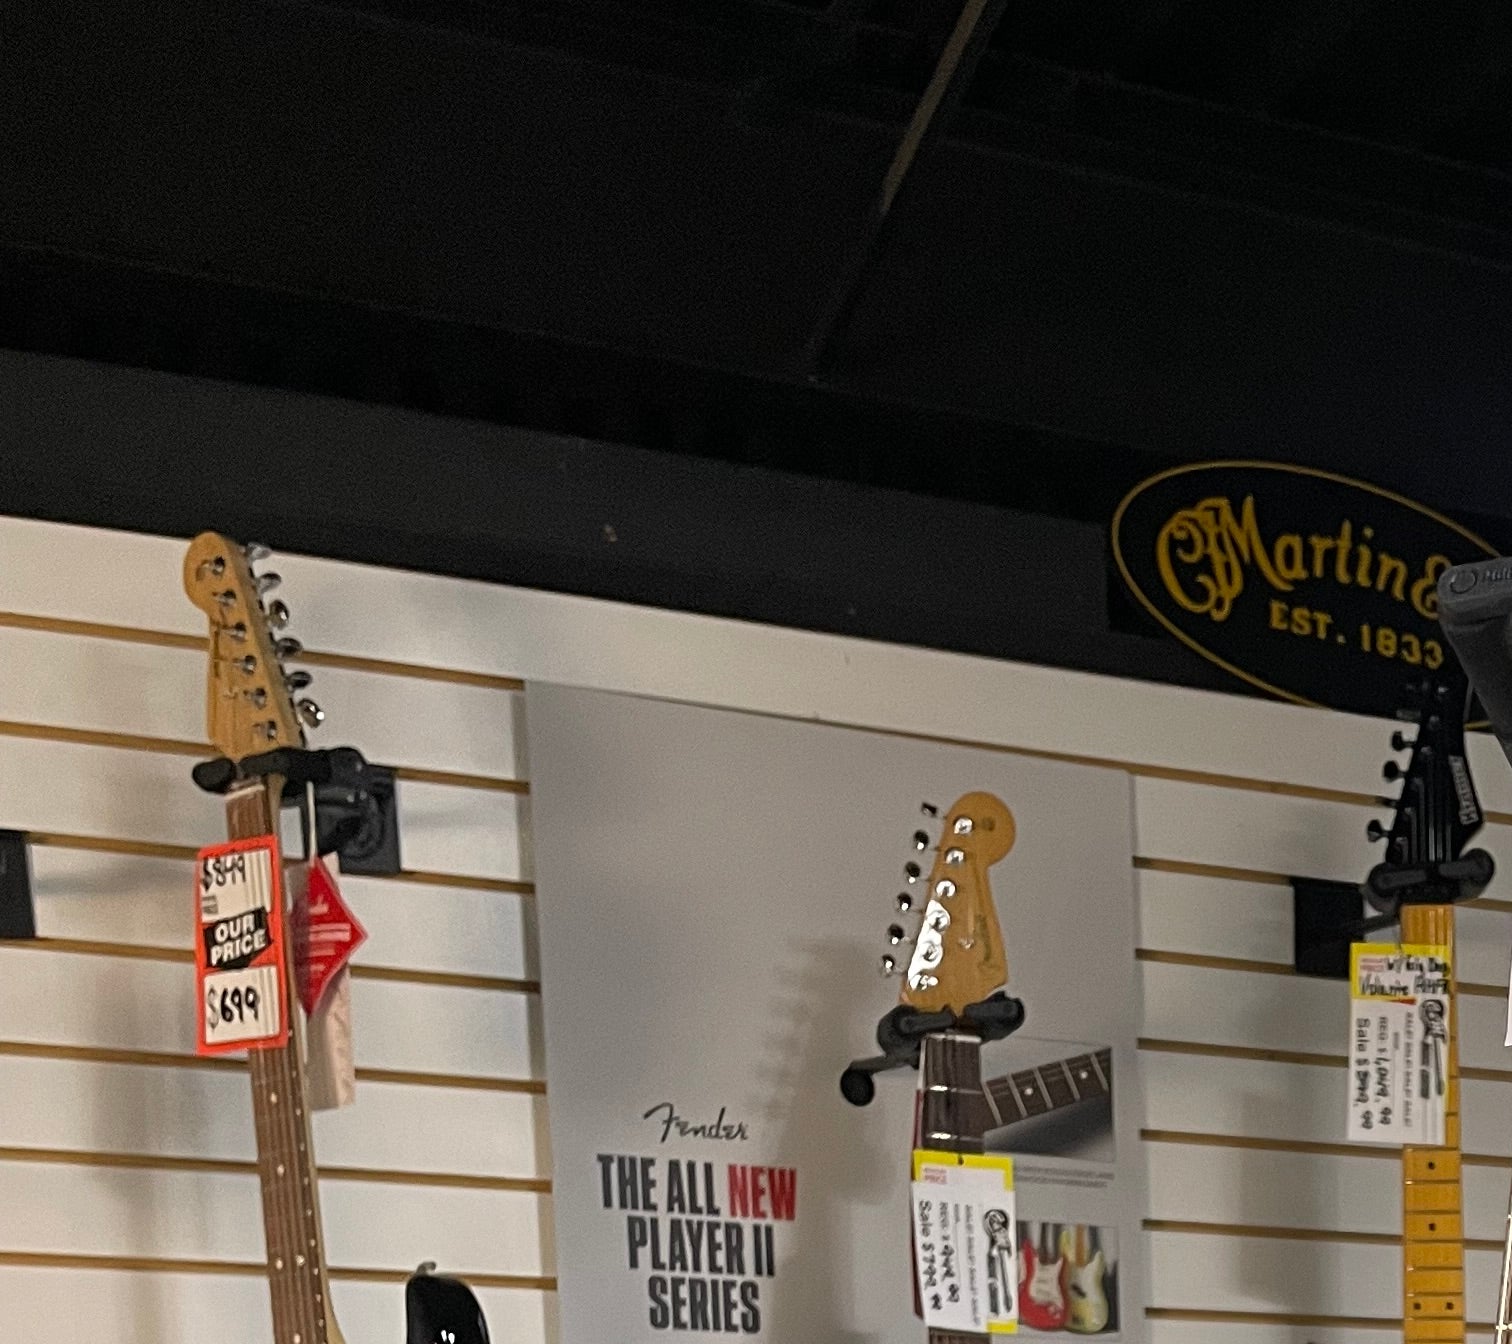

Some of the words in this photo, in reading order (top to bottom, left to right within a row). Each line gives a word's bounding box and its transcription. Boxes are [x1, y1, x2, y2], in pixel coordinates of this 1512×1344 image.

[1270, 600, 1346, 644] EST.
[1361, 623, 1444, 670] 1833
[209, 928, 268, 967] PRICE
[214, 913, 255, 943] OUR
[207, 984, 261, 1031] $699
[643, 1102, 749, 1143] Fender
[597, 1154, 658, 1211] THE
[666, 1159, 720, 1216] ALL
[727, 1164, 797, 1221] NEW
[627, 1215, 746, 1275] PLAYER
[753, 1224, 775, 1278] II
[648, 1275, 761, 1334] SERIES
